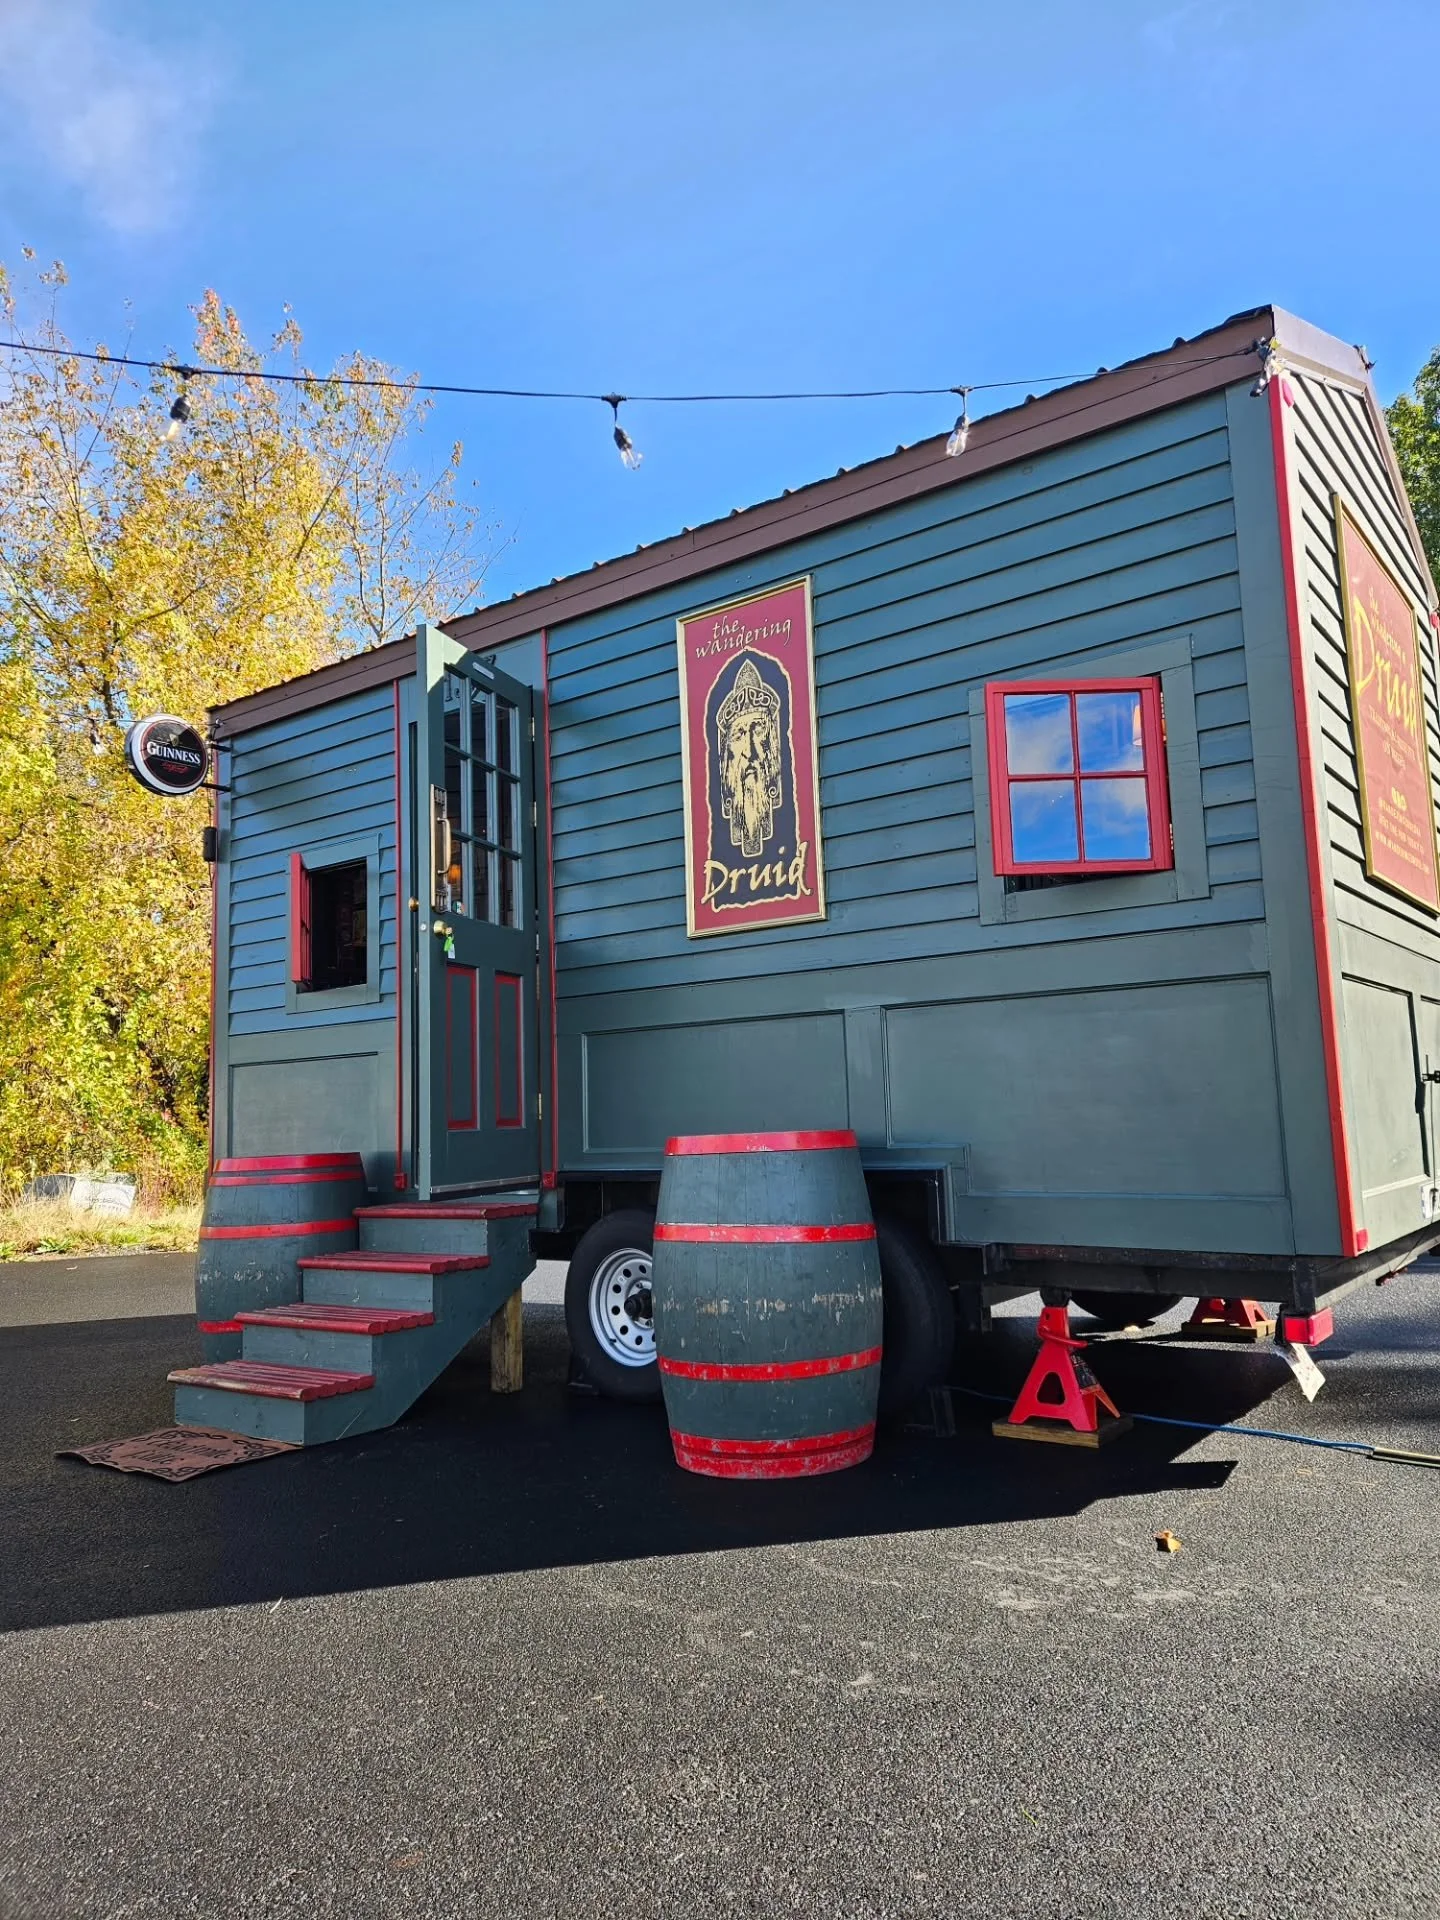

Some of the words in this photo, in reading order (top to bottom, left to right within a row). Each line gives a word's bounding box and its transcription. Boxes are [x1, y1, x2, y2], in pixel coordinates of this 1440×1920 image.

[695, 619, 792, 658] wandering
[712, 616, 740, 639] the
[146, 741, 201, 764] GUINNESS
[700, 841, 811, 904] Druid
